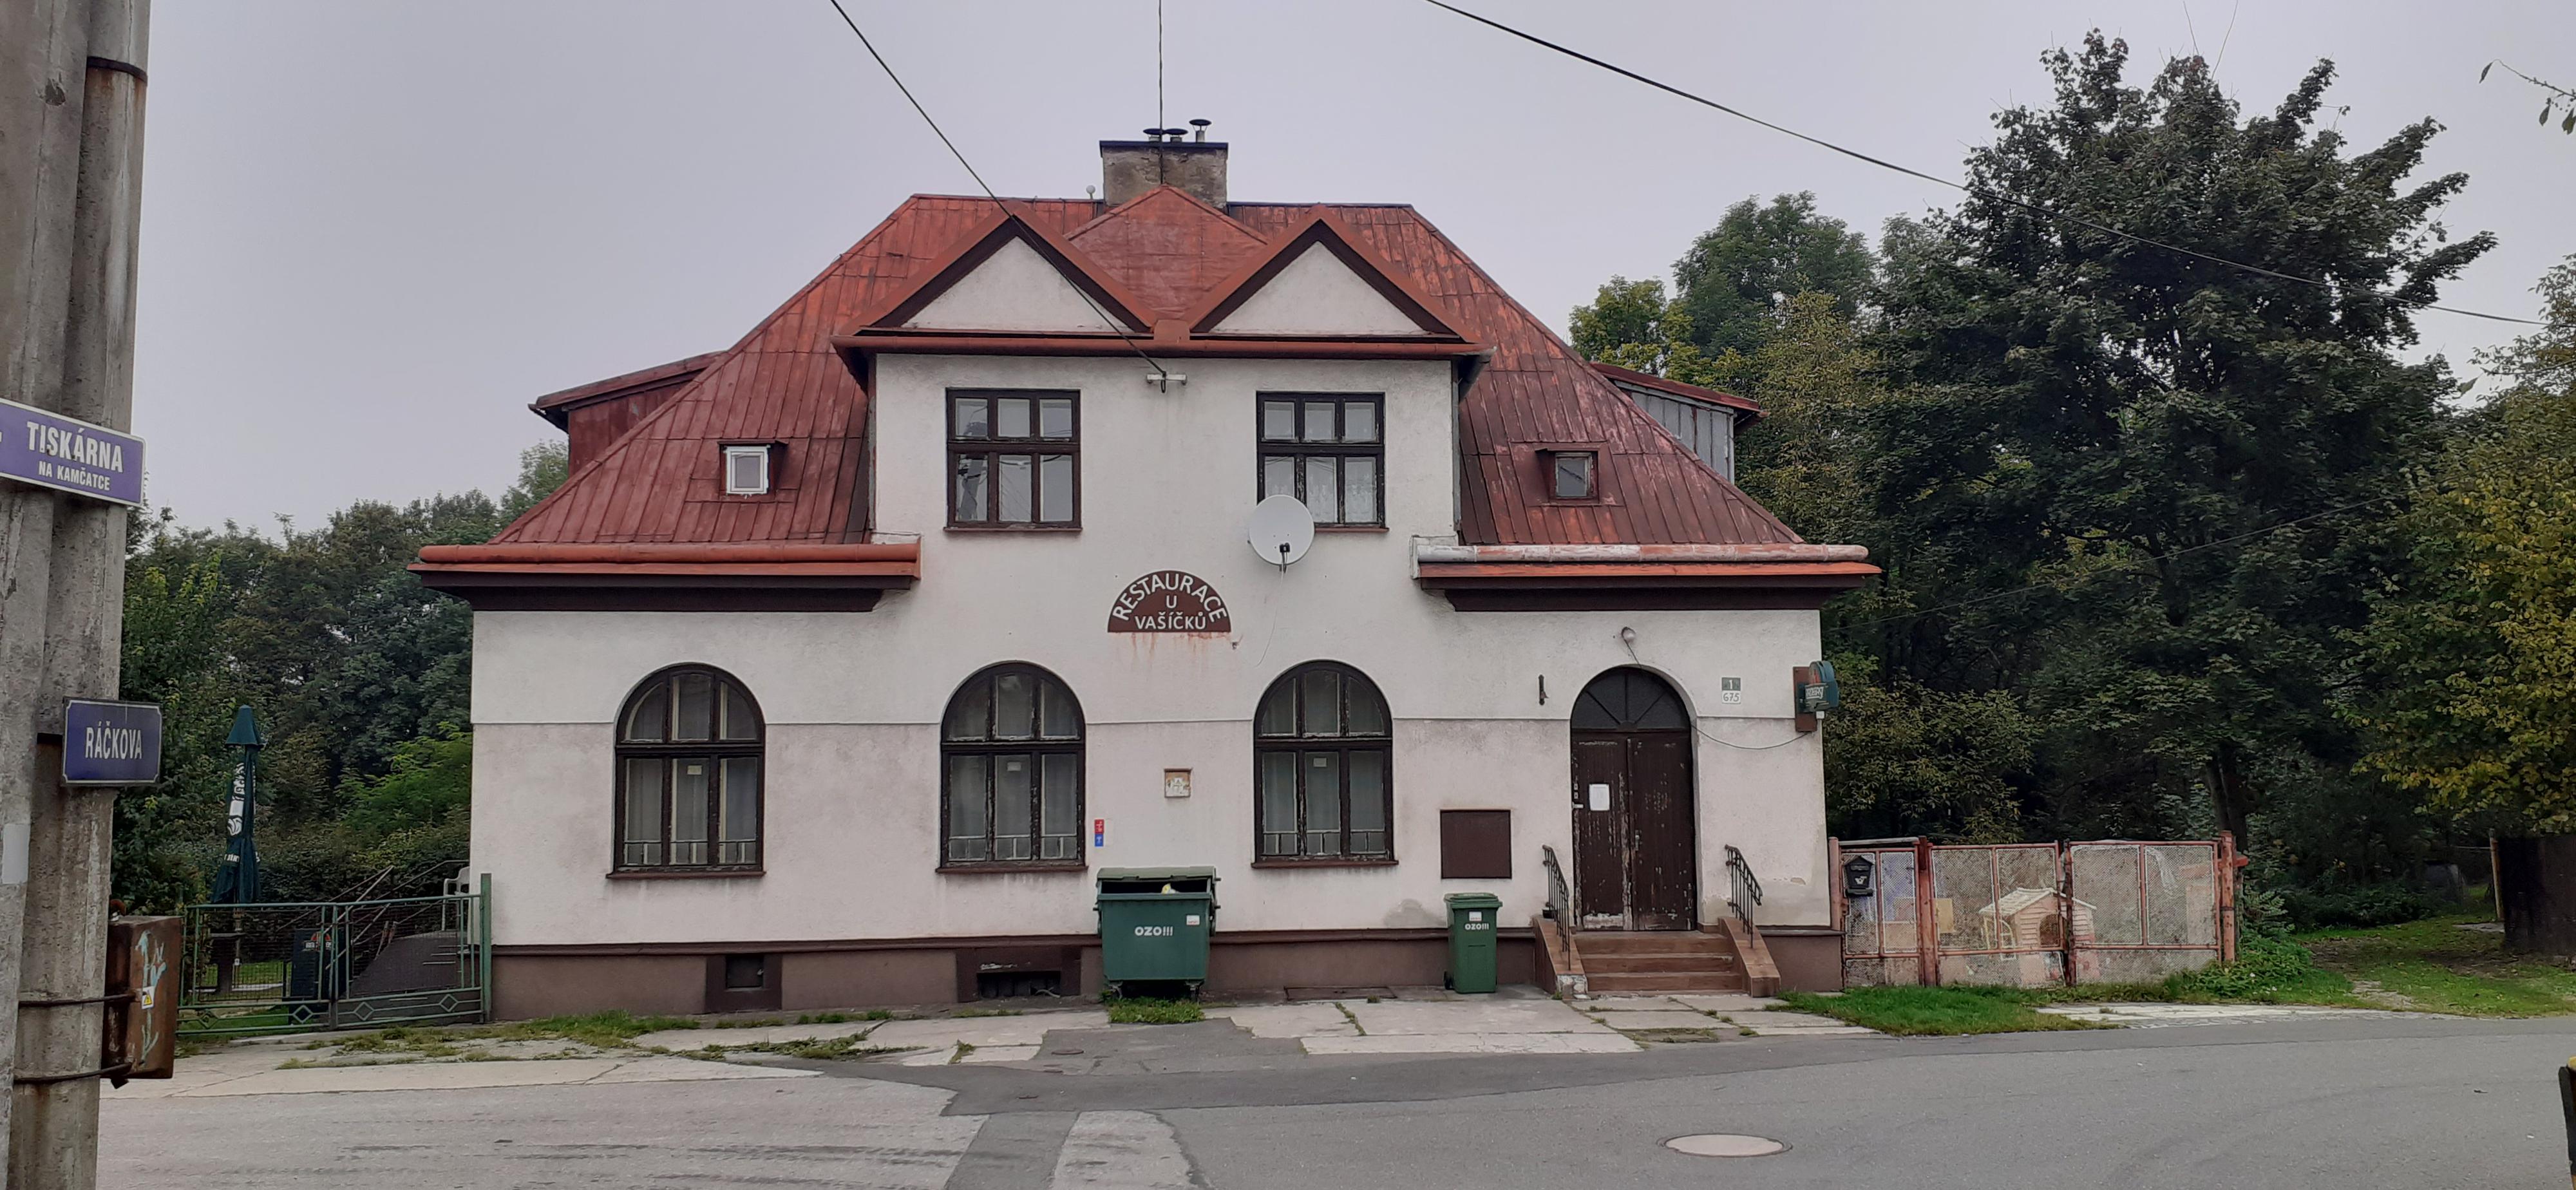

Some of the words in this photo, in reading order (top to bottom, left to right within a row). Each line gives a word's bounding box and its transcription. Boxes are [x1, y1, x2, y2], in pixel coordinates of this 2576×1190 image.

[27, 420, 124, 473] TISKÁRNA
[39, 460, 52, 478] NA
[57, 464, 110, 491] KAMČATCE
[1112, 572, 1227, 623] RESTAURACE
[1166, 595, 1177, 609] U
[1135, 611, 1206, 630] VAŠÍČKŮ
[1728, 679, 1733, 689] 1
[1723, 692, 1740, 702] 675
[85, 721, 142, 760] RÁČKOVA
